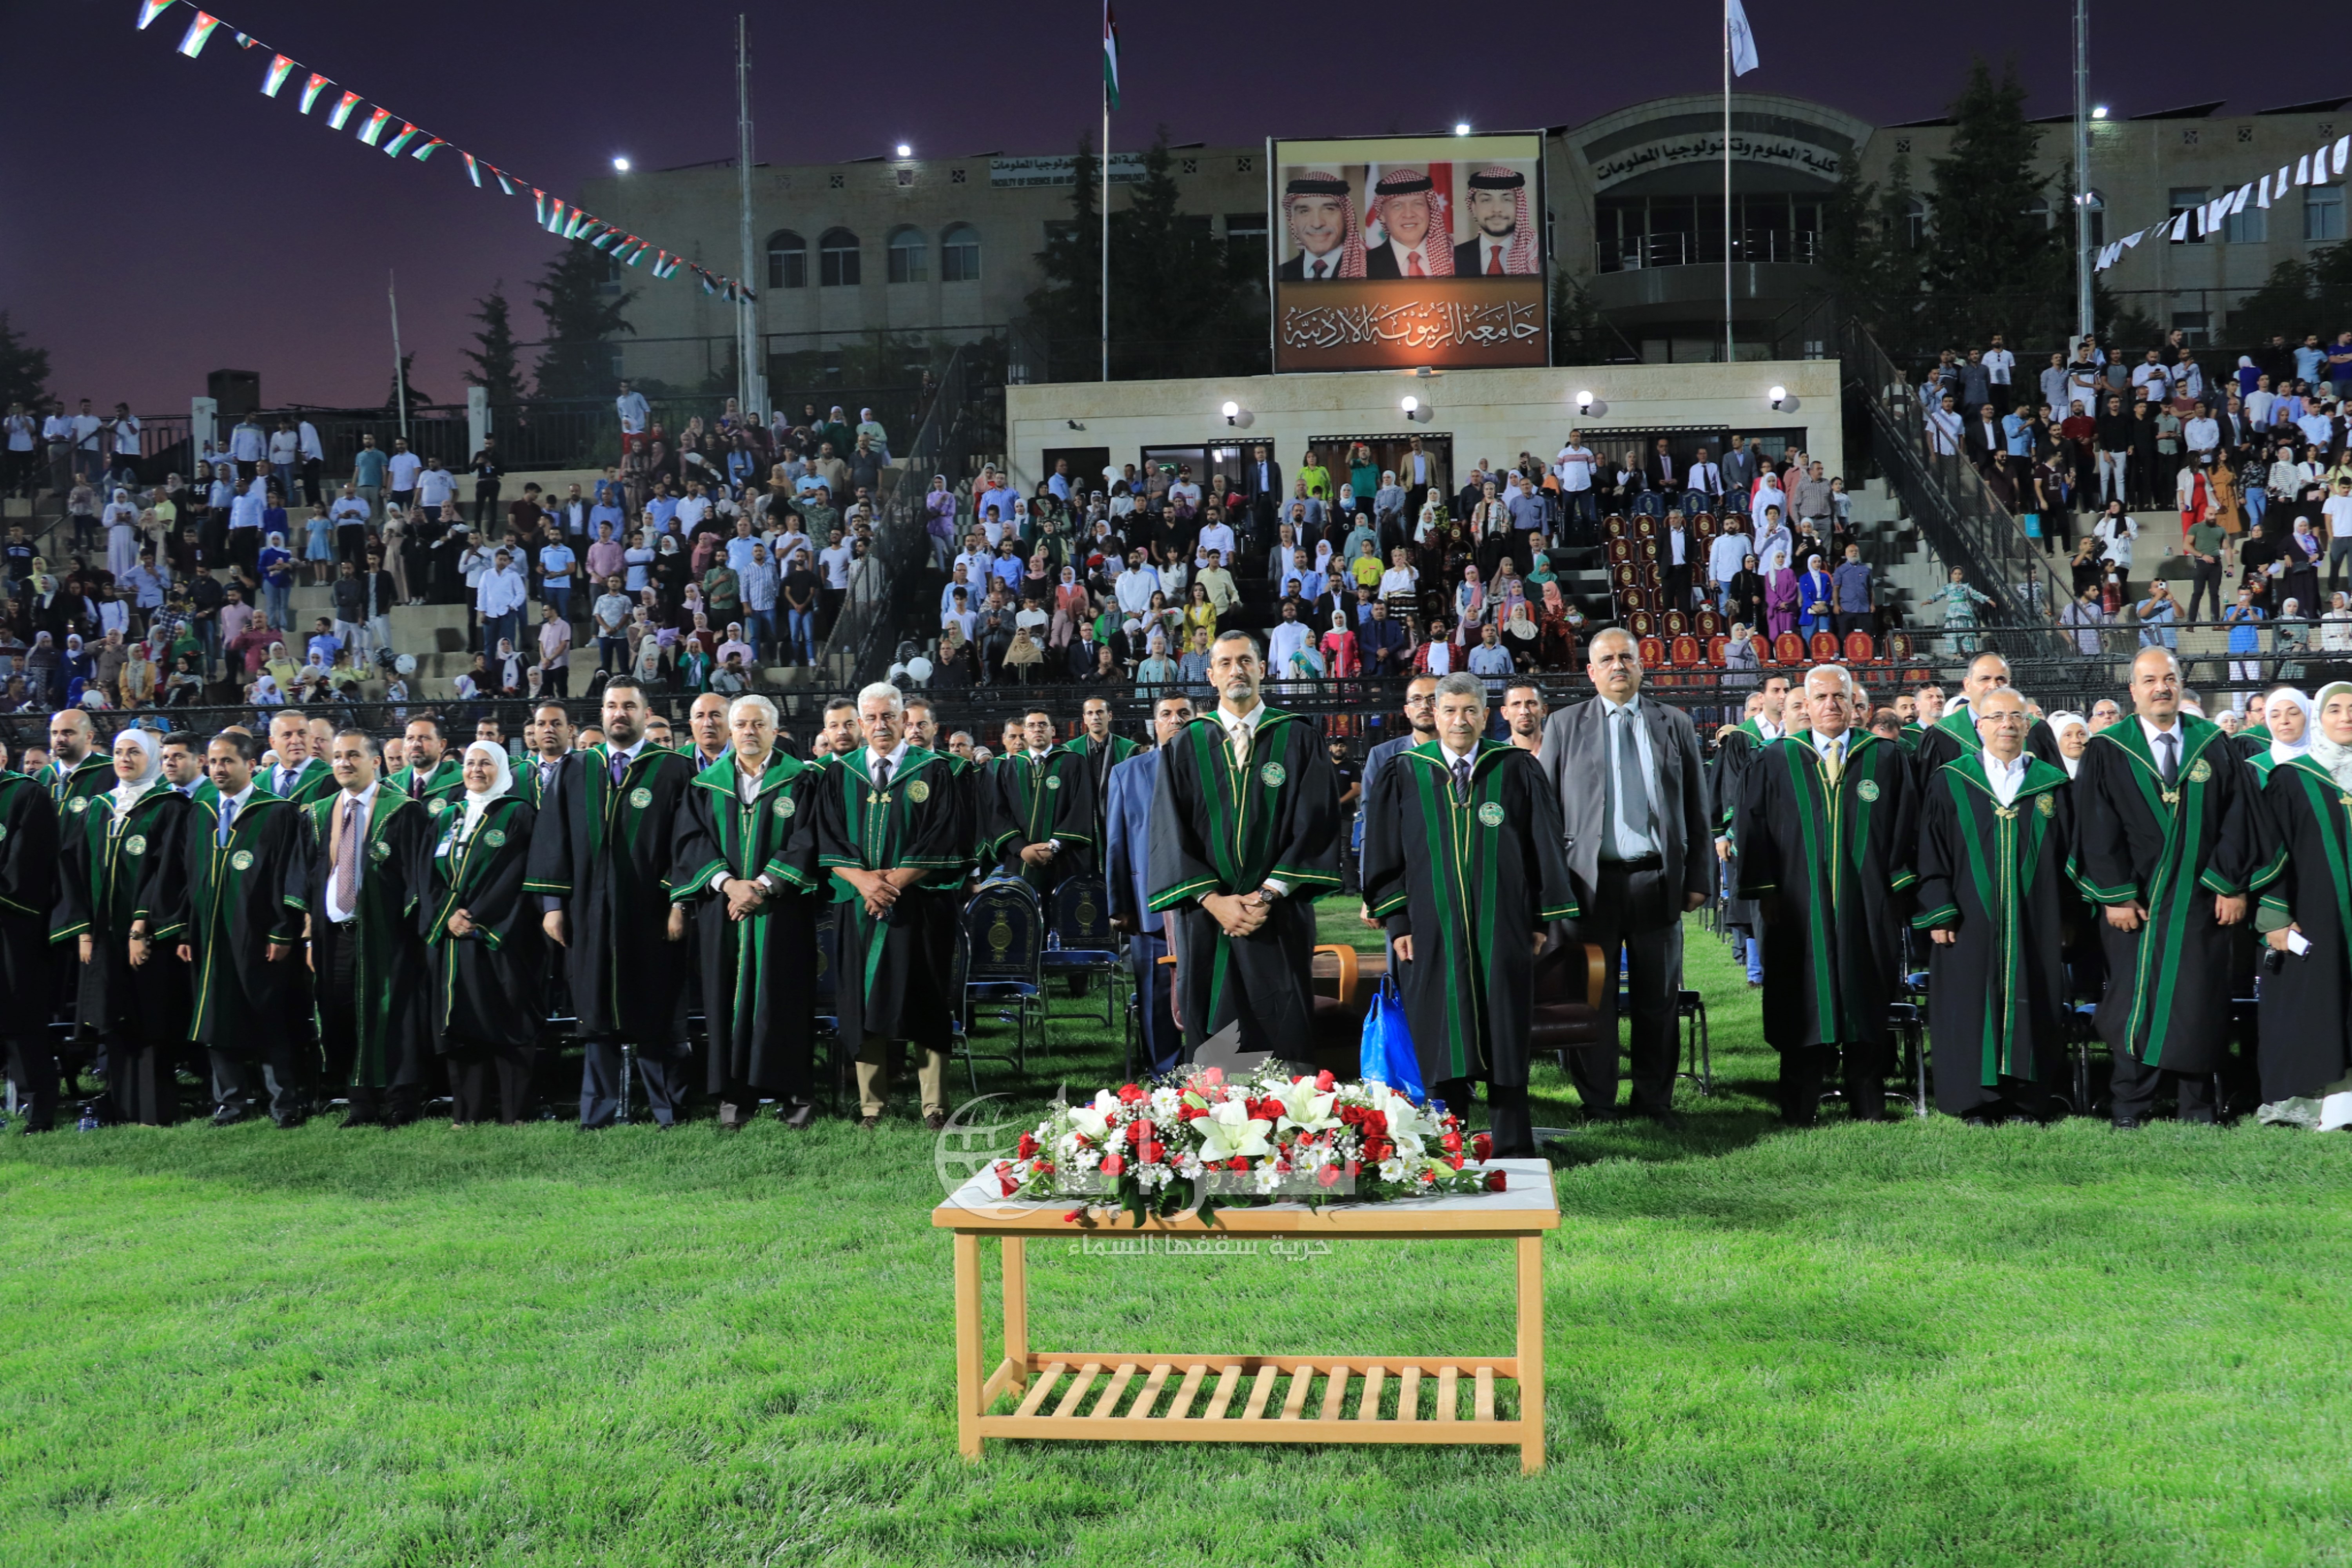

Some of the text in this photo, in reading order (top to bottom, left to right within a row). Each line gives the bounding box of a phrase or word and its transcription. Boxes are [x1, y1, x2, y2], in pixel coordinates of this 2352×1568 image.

[1752, 142, 1800, 160] العلوم
[991, 160, 1033, 171] المعلومات
[1597, 147, 1660, 180] المعلومات
[1803, 149, 1838, 172] كلية
[1017, 177, 1025, 186] OF
